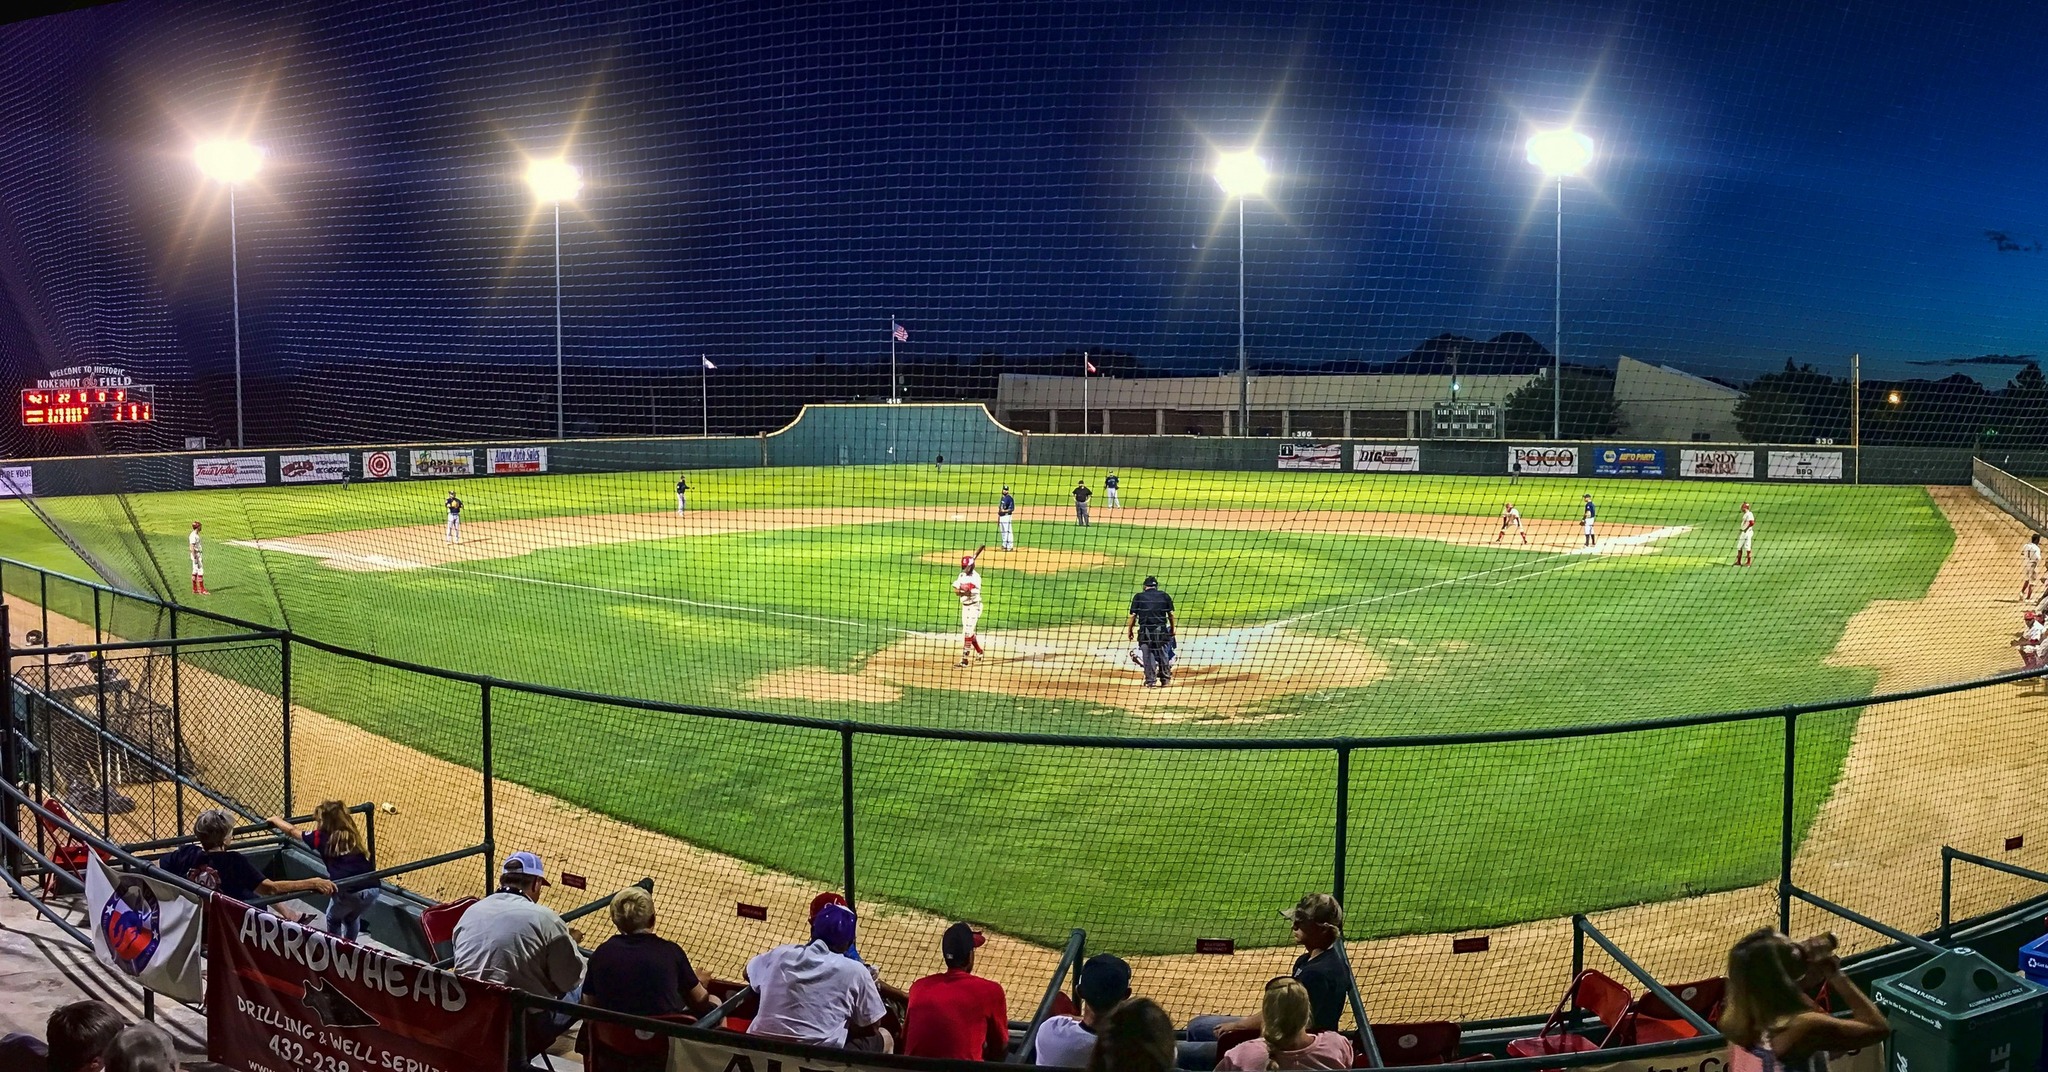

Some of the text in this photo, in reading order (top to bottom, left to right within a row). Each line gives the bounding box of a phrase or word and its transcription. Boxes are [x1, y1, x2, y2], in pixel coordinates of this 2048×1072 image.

[49, 365, 125, 378] WELCOME TO HISTORIC
[37, 379, 80, 389] KOKERNOT
[99, 376, 132, 387] FIELD
[1816, 437, 1833, 445] 330
[1619, 453, 1656, 461] AUTO PARTS
[1695, 452, 1739, 463] HARDY
[239, 907, 468, 1012] ARROWHEAD
[236, 995, 315, 1039] DRILLING
[319, 1032, 327, 1046] &
[329, 1032, 377, 1065] WELL
